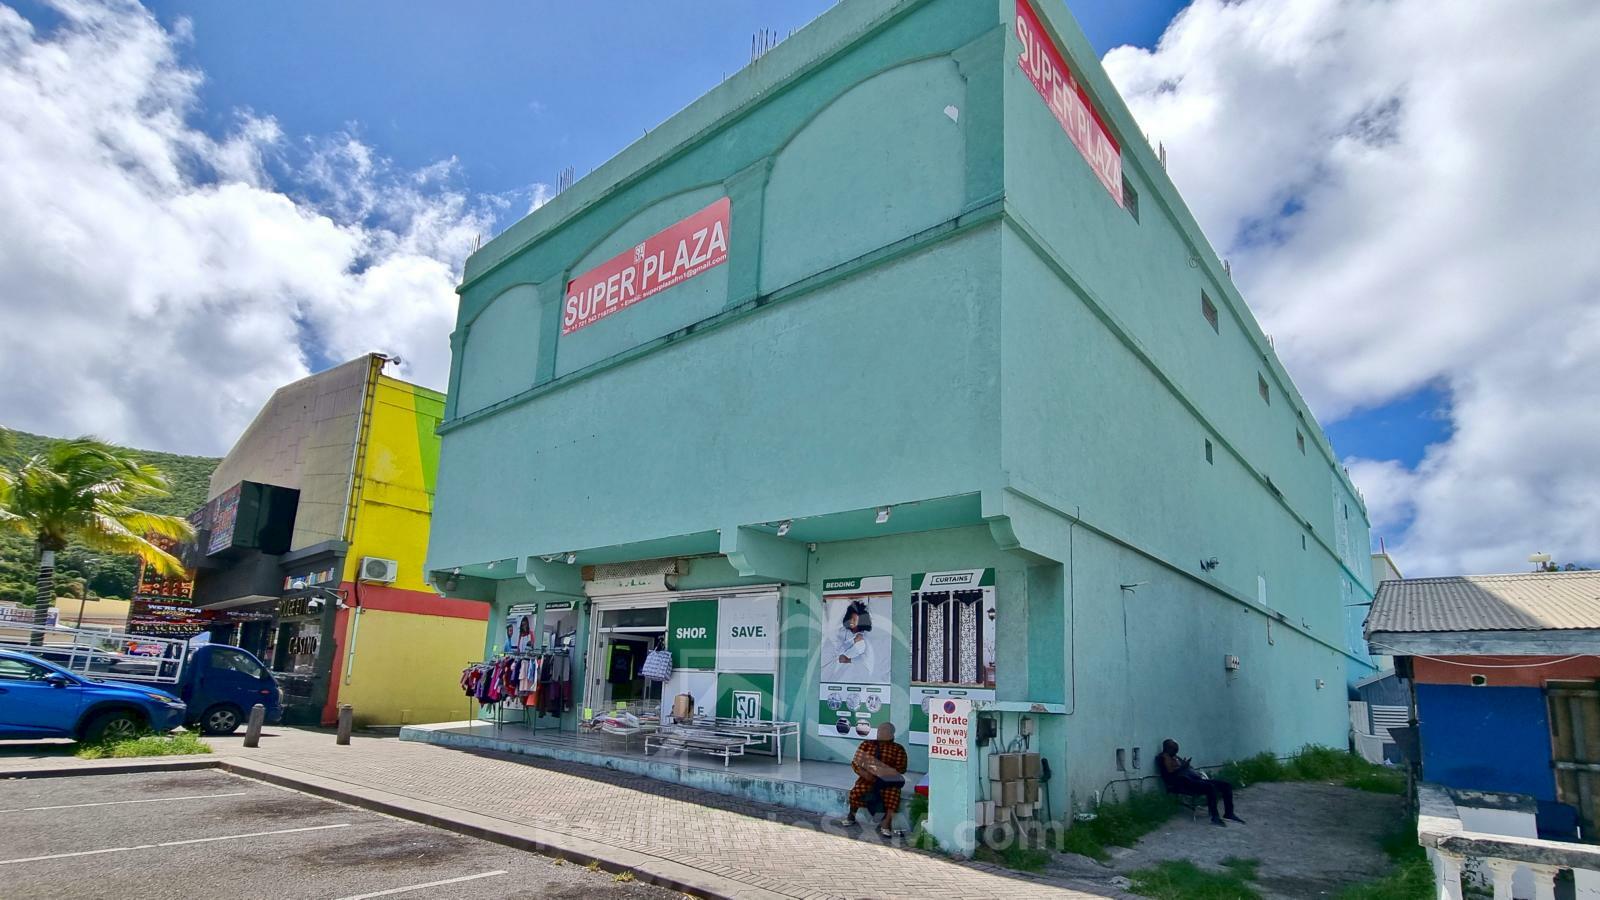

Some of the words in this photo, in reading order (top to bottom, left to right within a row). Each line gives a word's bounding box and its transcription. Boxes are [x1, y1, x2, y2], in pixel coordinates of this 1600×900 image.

[1017, 15, 1074, 131] SUPER
[1078, 103, 1122, 200] PLAZA
[564, 266, 636, 326] SUPER
[641, 220, 727, 291] PLAZA
[825, 581, 855, 589] BEDDING
[935, 575, 968, 583] CURTAINS
[676, 627, 707, 639] SHOP.
[731, 625, 767, 638] SAVE.
[288, 636, 319, 655] CASINO
[932, 713, 968, 726] Private
[932, 725, 951, 736] Drive
[952, 729, 968, 738] way
[936, 736, 947, 745] Do
[948, 737, 963, 746] Not
